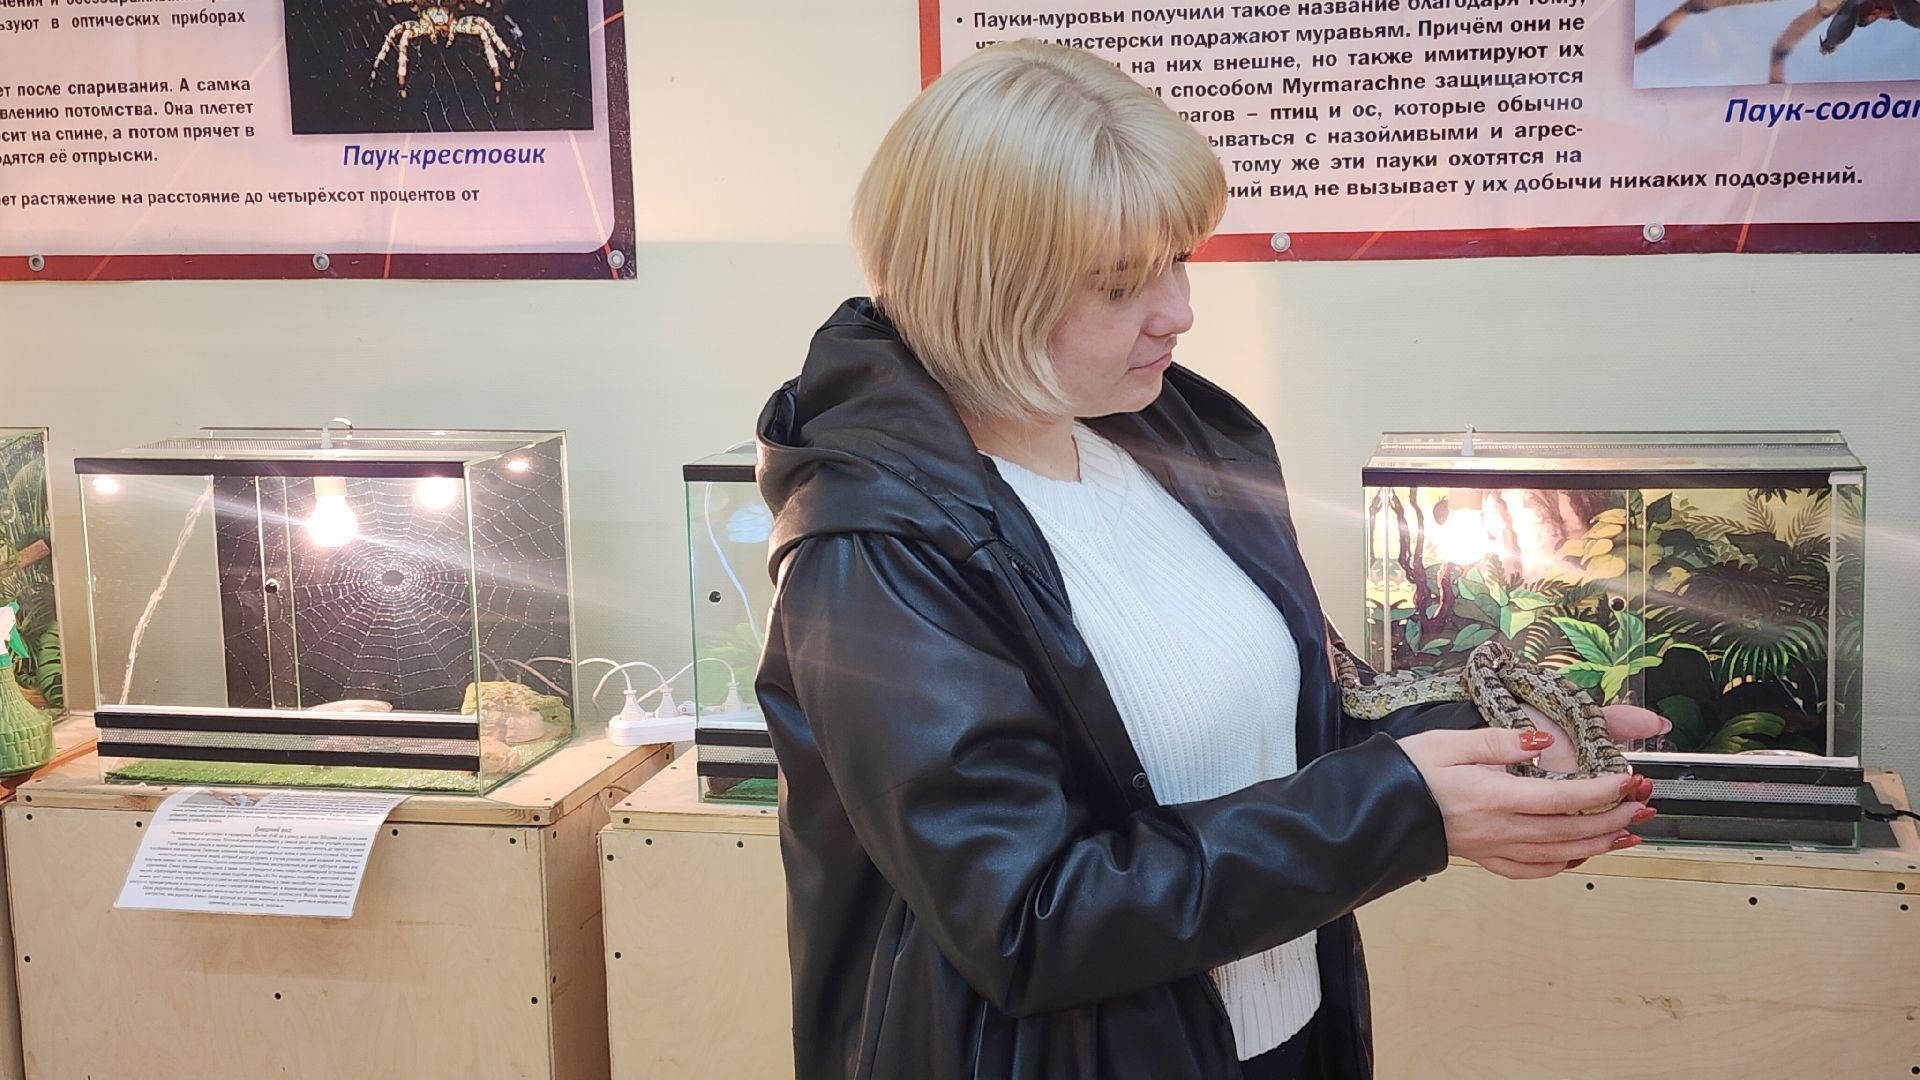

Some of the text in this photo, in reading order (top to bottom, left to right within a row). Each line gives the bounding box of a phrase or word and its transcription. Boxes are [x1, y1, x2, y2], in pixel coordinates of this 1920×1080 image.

[51, 17, 60, 29] в
[71, 14, 161, 29] оптических
[171, 7, 246, 28] приборах
[973, 10, 1125, 31] Пауки-муровьи
[1131, 6, 1225, 25] получили
[1231, 3, 1291, 18] такое
[1297, 0, 1401, 16] название
[1055, 16, 1585, 53] мастерски подражают муравьям. Причём они не
[1131, 60, 1155, 74] на
[1166, 59, 1203, 73] них
[1213, 55, 1301, 71] внешне,
[1312, 53, 1338, 68] но
[1347, 51, 1413, 66] также
[1424, 45, 1549, 64] имитируют
[1559, 44, 1585, 58] их
[17, 84, 61, 97] после
[67, 81, 173, 98] спаривания.
[179, 77, 190, 92] А
[196, 79, 251, 92] самка
[1170, 78, 1273, 98] способом
[1282, 74, 1426, 98] Myrmarachne
[1434, 70, 1583, 90] защищаются
[0, 100, 254, 120] влению потомства. Она плетет
[1270, 106, 1319, 121] птиц
[1329, 105, 1341, 118] и
[1352, 104, 1382, 120] ос,
[1394, 100, 1486, 119] которые
[1497, 94, 1583, 113] обычно
[31, 130, 51, 142] на
[55, 128, 108, 142] спине,
[112, 128, 122, 140] а
[128, 127, 179, 139] потом
[183, 126, 241, 141] прячет
[245, 126, 255, 137] в
[1305, 132, 1317, 145] с
[1327, 124, 1478, 144] назойливыми
[1490, 126, 1503, 139] и
[1514, 124, 1583, 142] агрес-
[0, 148, 158, 167] дятся её отпрыски.
[343, 145, 546, 171] Паук-крестовик
[1231, 159, 1282, 175] тому
[1291, 157, 1320, 171] же
[1330, 156, 1365, 170] эти
[1376, 154, 1437, 172] пауки
[1448, 151, 1544, 167] охотятся
[1555, 149, 1582, 164] на
[1270, 184, 1309, 199] вид
[1314, 183, 1340, 196] не
[1347, 180, 1459, 196] вызывает
[1464, 179, 1476, 196] у
[1482, 179, 1508, 192] их
[1513, 172, 1602, 194] добычи
[1610, 173, 1707, 189] никаких
[1715, 165, 1863, 189] подозрений.
[21, 194, 116, 209] растяжение
[121, 193, 143, 204] на
[147, 192, 240, 207] расстояние
[244, 192, 263, 205] до
[268, 187, 365, 206] четырёхсот
[370, 190, 456, 205] процентов
[461, 189, 480, 202] от
